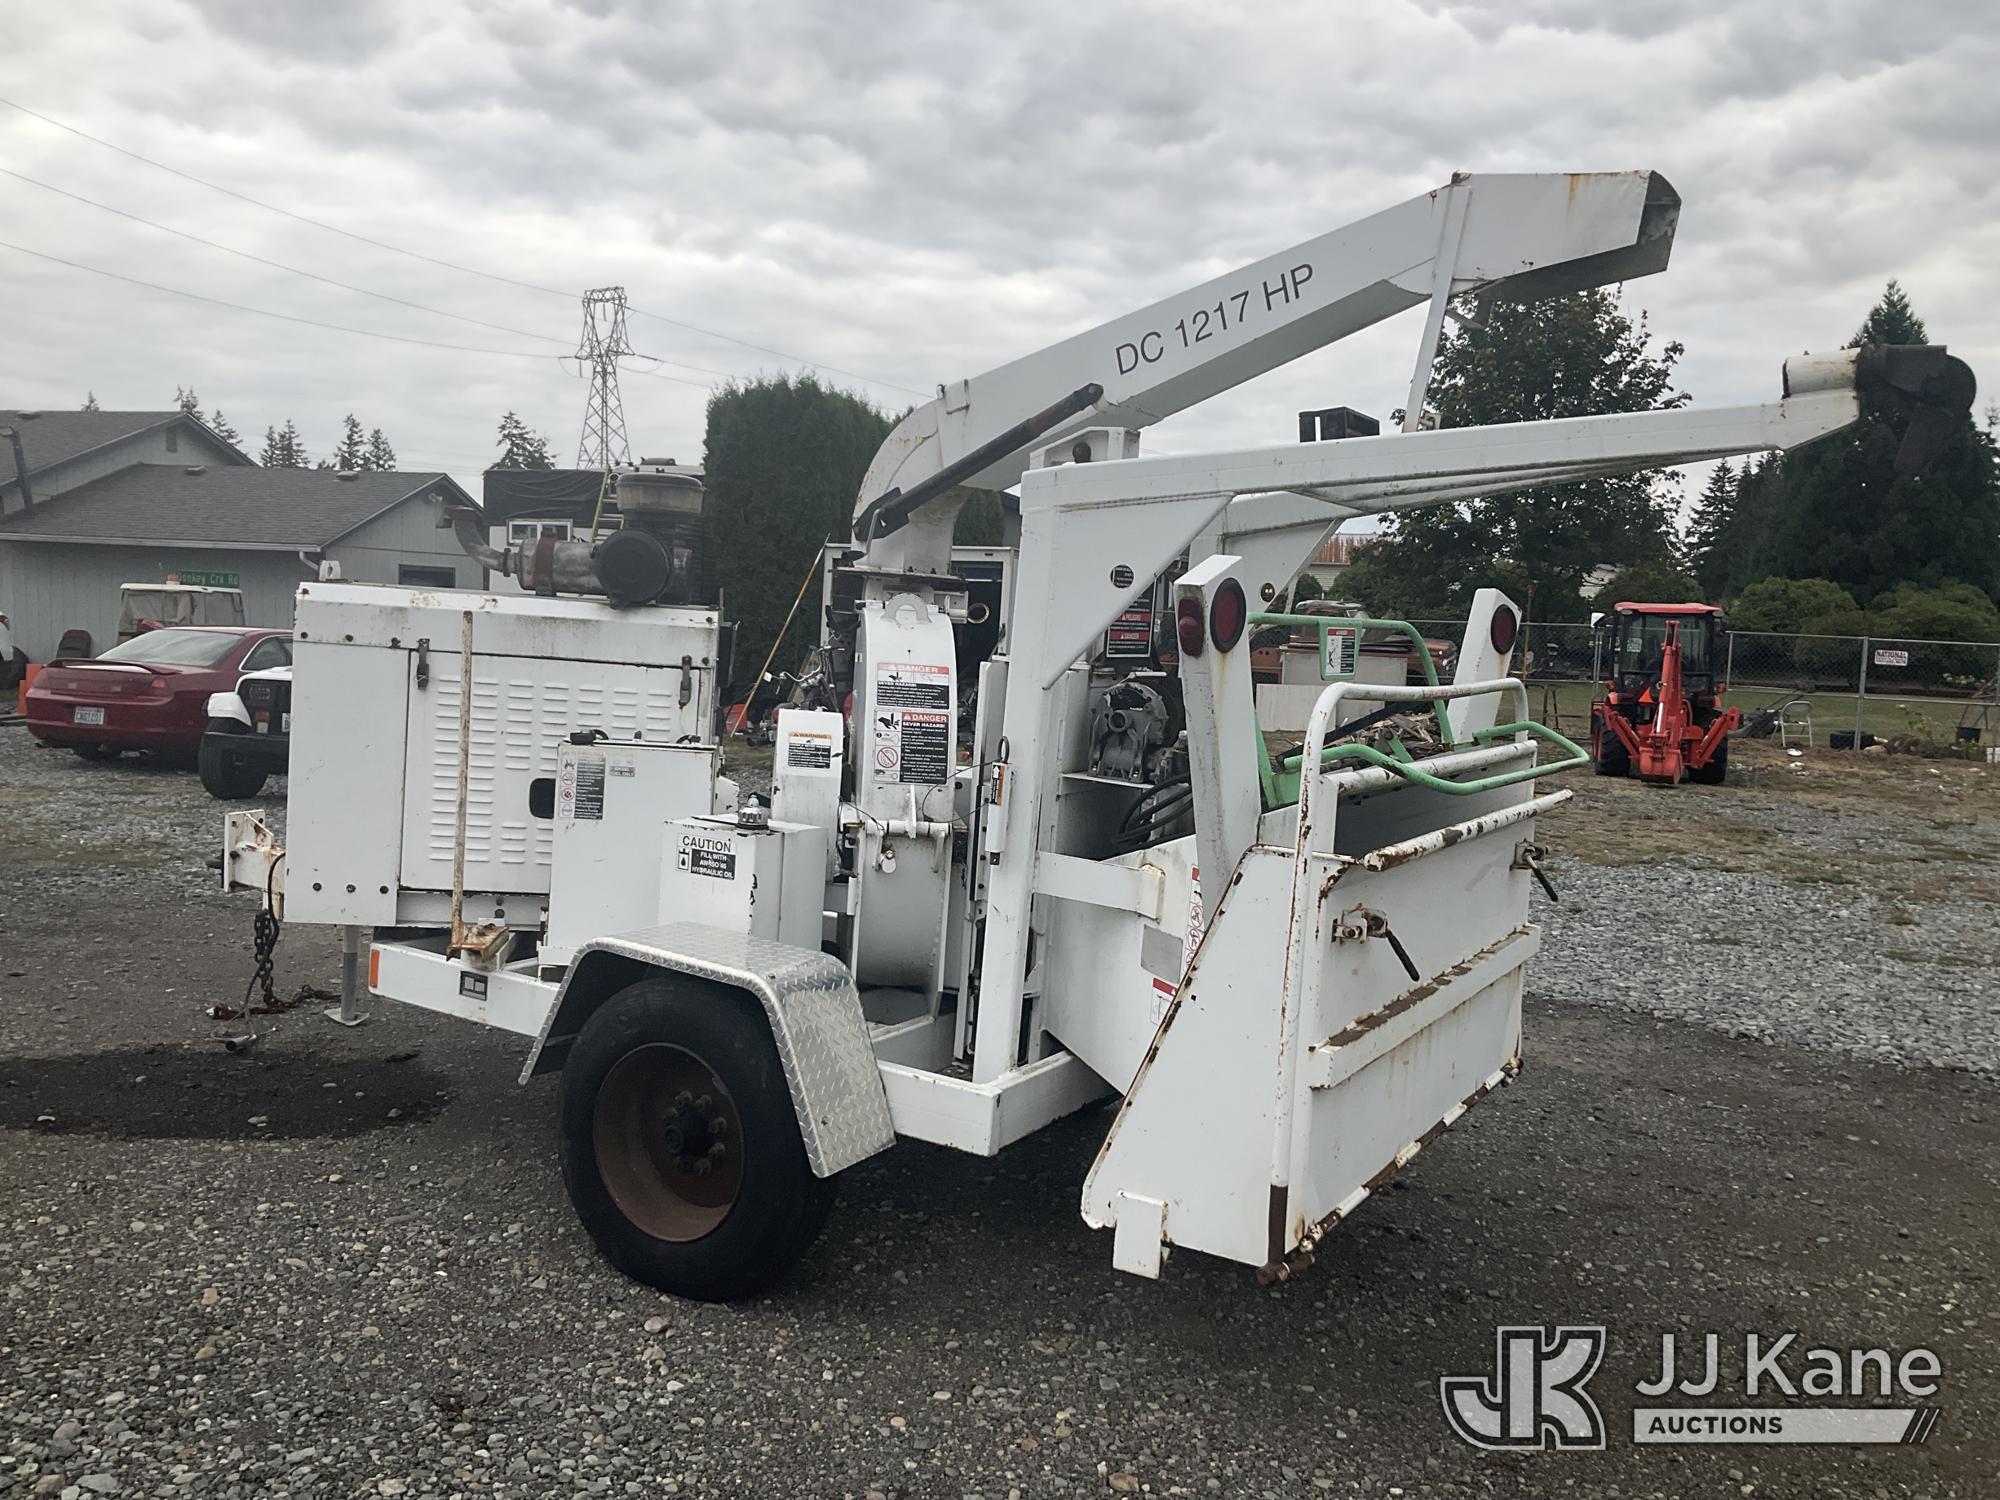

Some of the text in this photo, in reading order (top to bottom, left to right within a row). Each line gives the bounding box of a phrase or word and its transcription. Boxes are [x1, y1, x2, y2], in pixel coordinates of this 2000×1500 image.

[1115, 263, 1314, 376] DC 1217 HP
[228, 574, 240, 586] Rd
[1876, 650, 1907, 659] NATIONAL
[897, 665, 939, 673] DANGER
[682, 835, 731, 853] CAUTION
[700, 851, 727, 861] FILL WITH
[691, 866, 724, 876] HYDRAULIC
